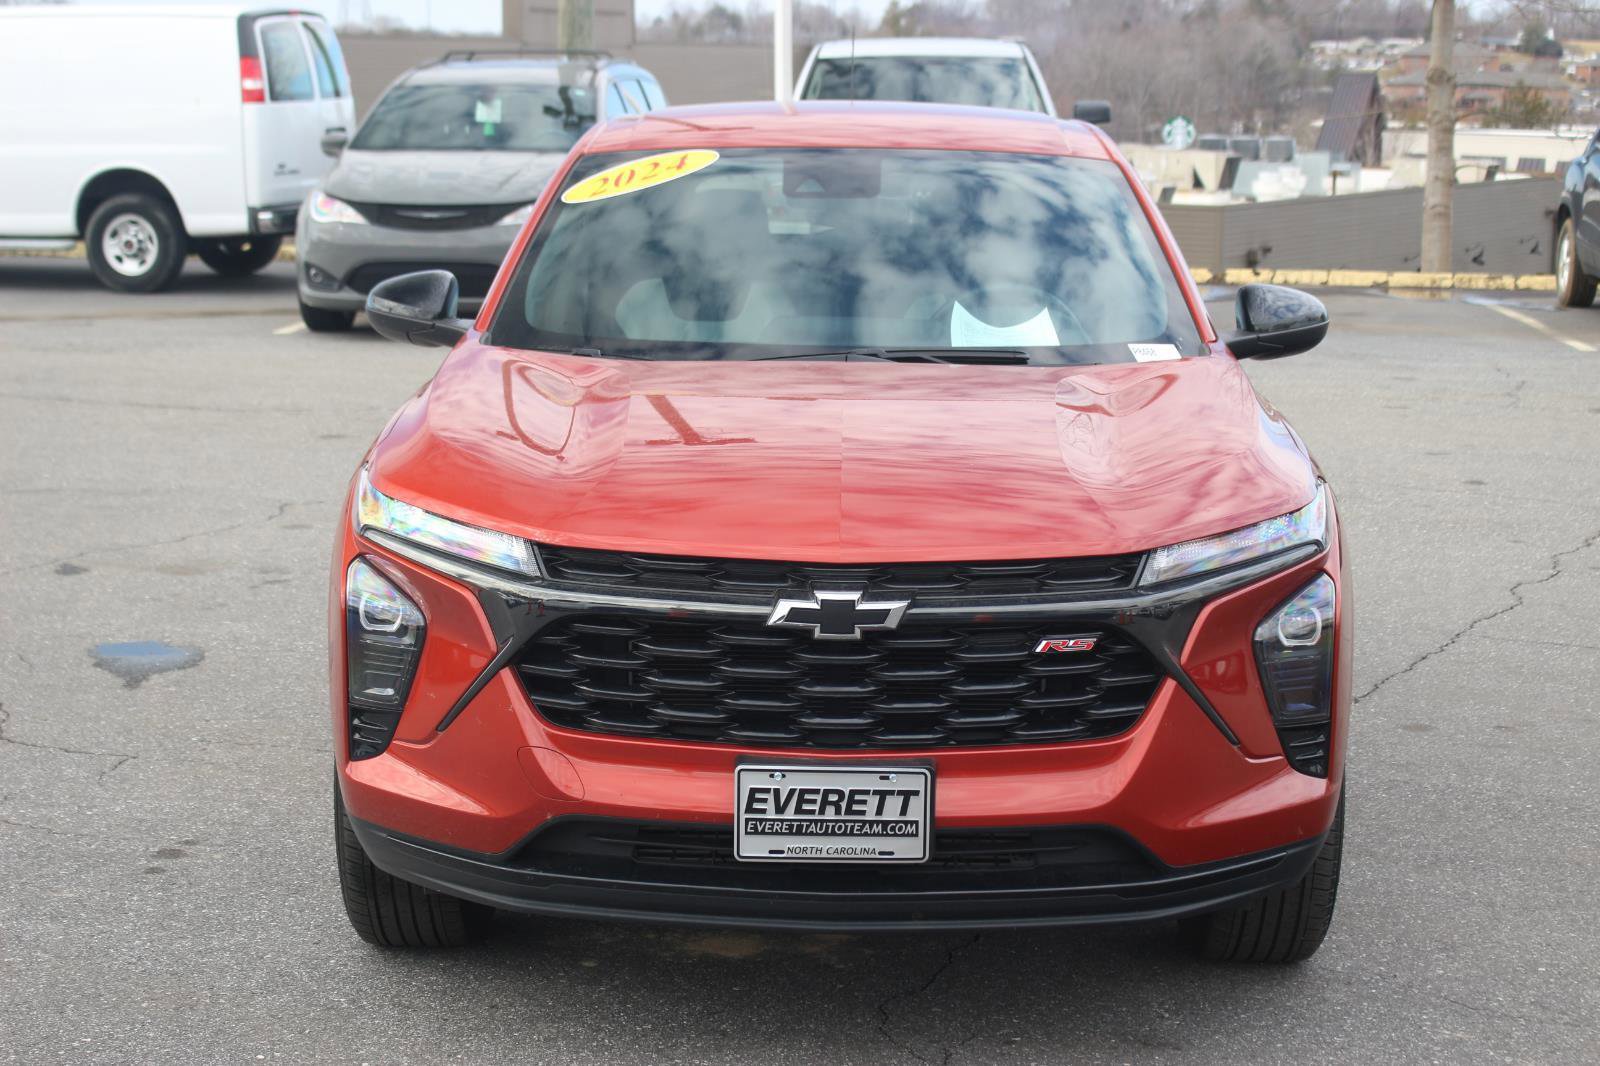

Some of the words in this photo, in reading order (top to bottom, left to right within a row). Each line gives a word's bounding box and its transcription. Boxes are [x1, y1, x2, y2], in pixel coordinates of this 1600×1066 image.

[590, 154, 689, 197] 2024
[1035, 638, 1097, 652] RS
[744, 787, 920, 817] EVERETT
[747, 820, 917, 835] EVERETTAUTOTEAM.COM
[786, 846, 825, 856] NORTH
[826, 846, 877, 857] CAROLINA
